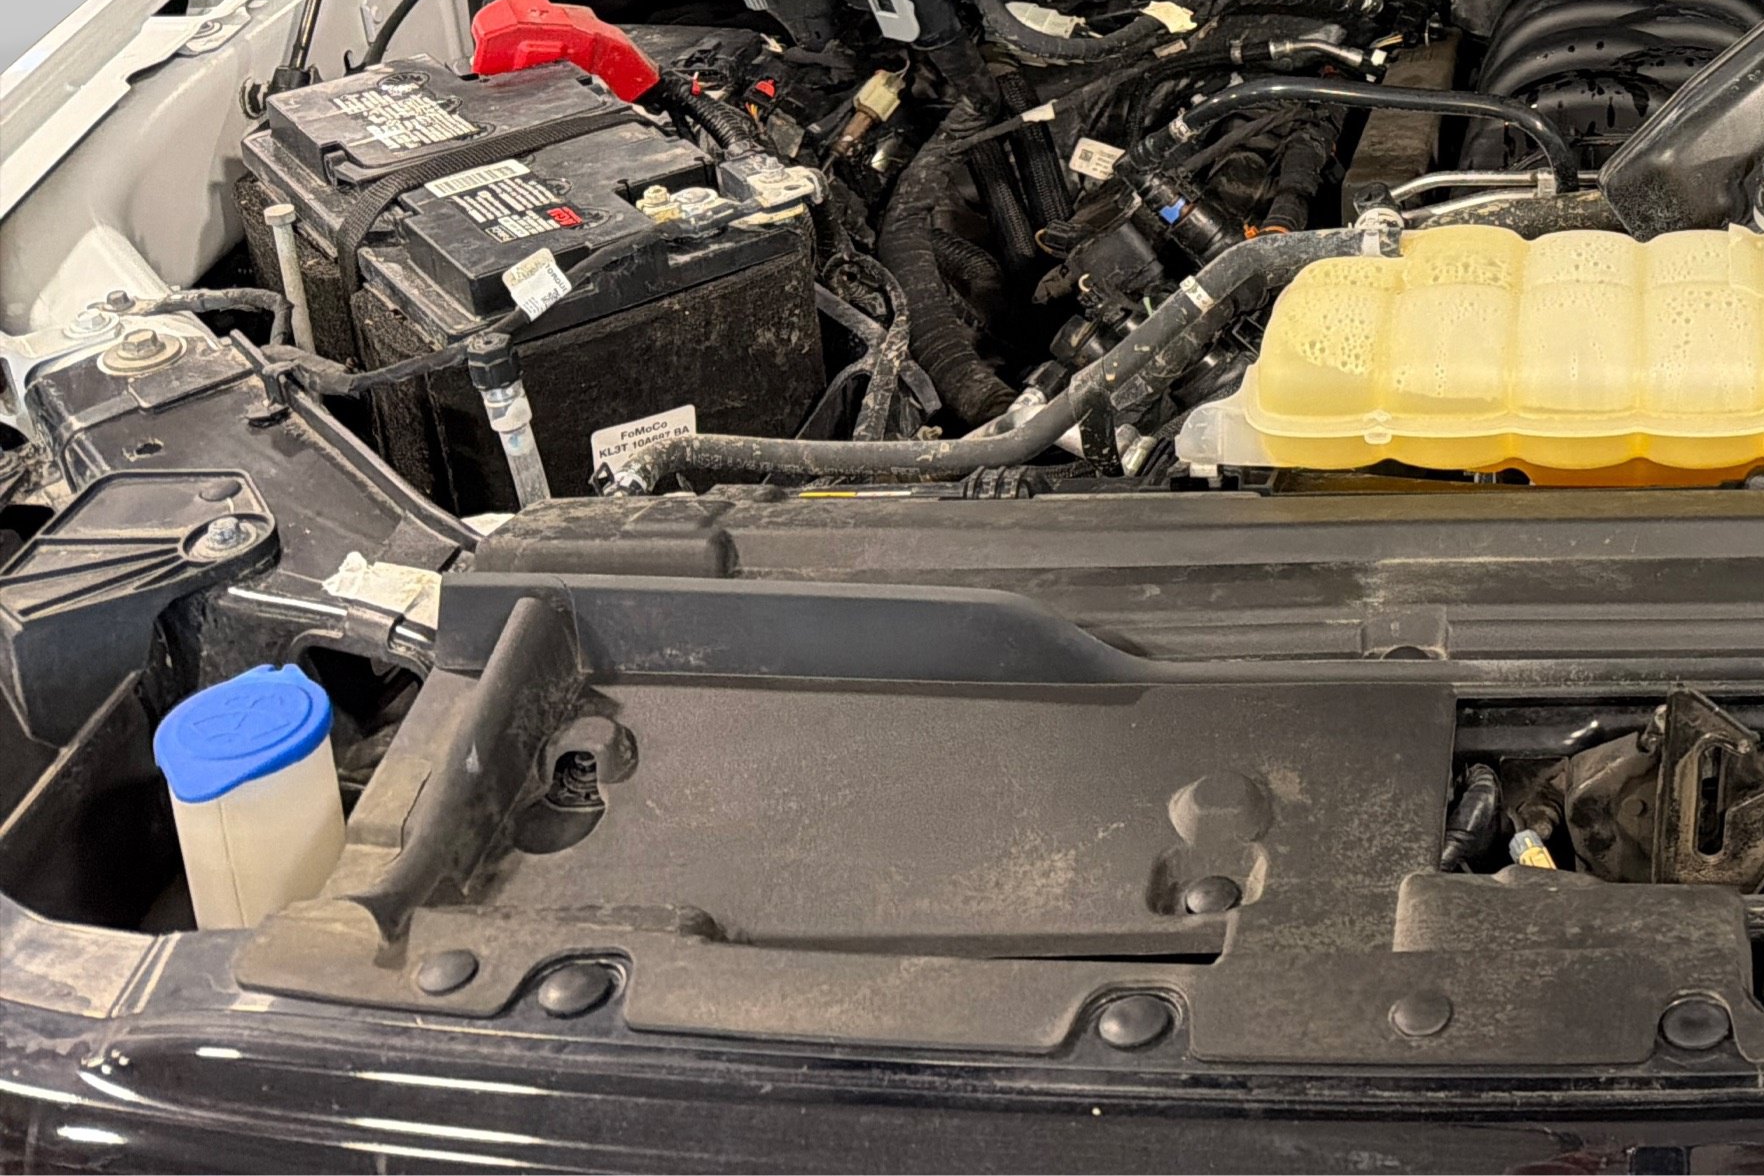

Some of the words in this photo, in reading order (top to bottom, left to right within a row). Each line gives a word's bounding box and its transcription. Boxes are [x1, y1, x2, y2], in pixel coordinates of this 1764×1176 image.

[599, 443, 629, 459] KL3T
[673, 425, 690, 437] BA
[620, 421, 668, 441] FoMoCo
